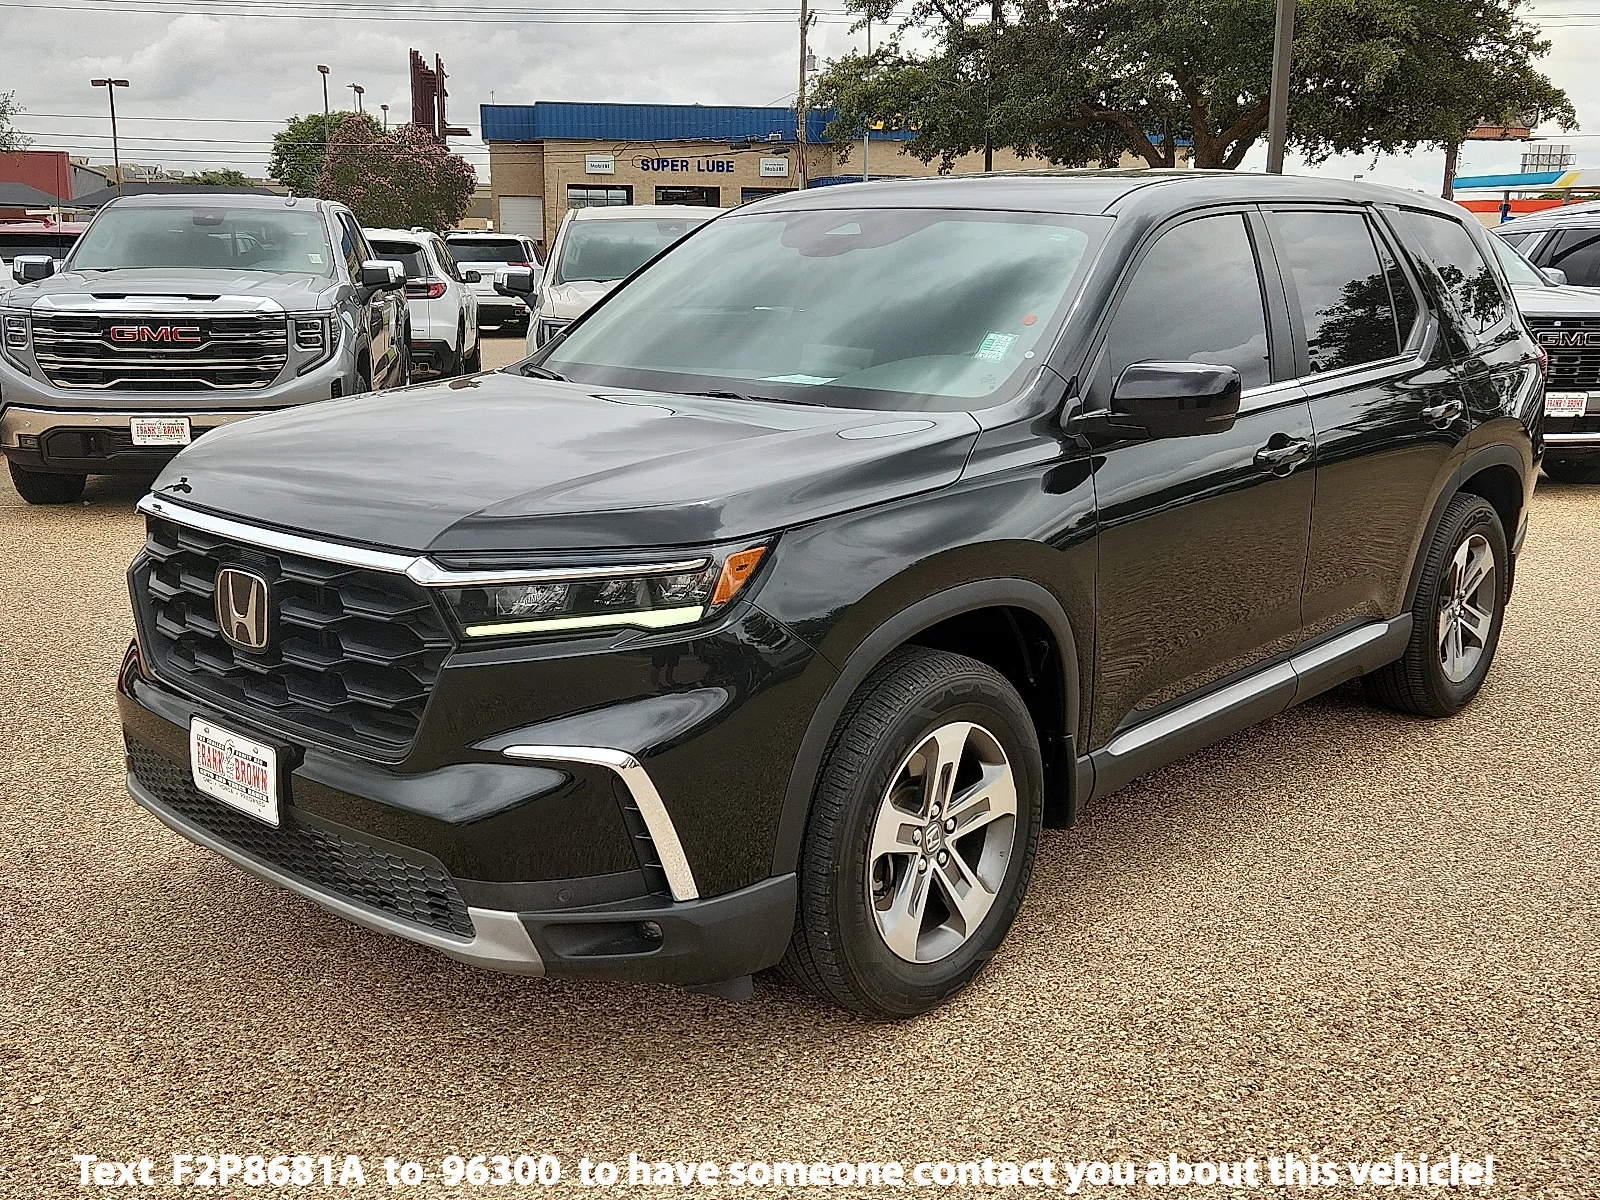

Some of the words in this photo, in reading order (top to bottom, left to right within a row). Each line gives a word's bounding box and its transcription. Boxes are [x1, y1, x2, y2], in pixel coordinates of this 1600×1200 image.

[640, 159, 689, 172] SUPER
[697, 160, 735, 173] LUBE
[110, 325, 201, 342] GMC
[1536, 331, 1600, 346] GMC
[196, 741, 226, 775] FRANK
[234, 757, 268, 793] BROWN
